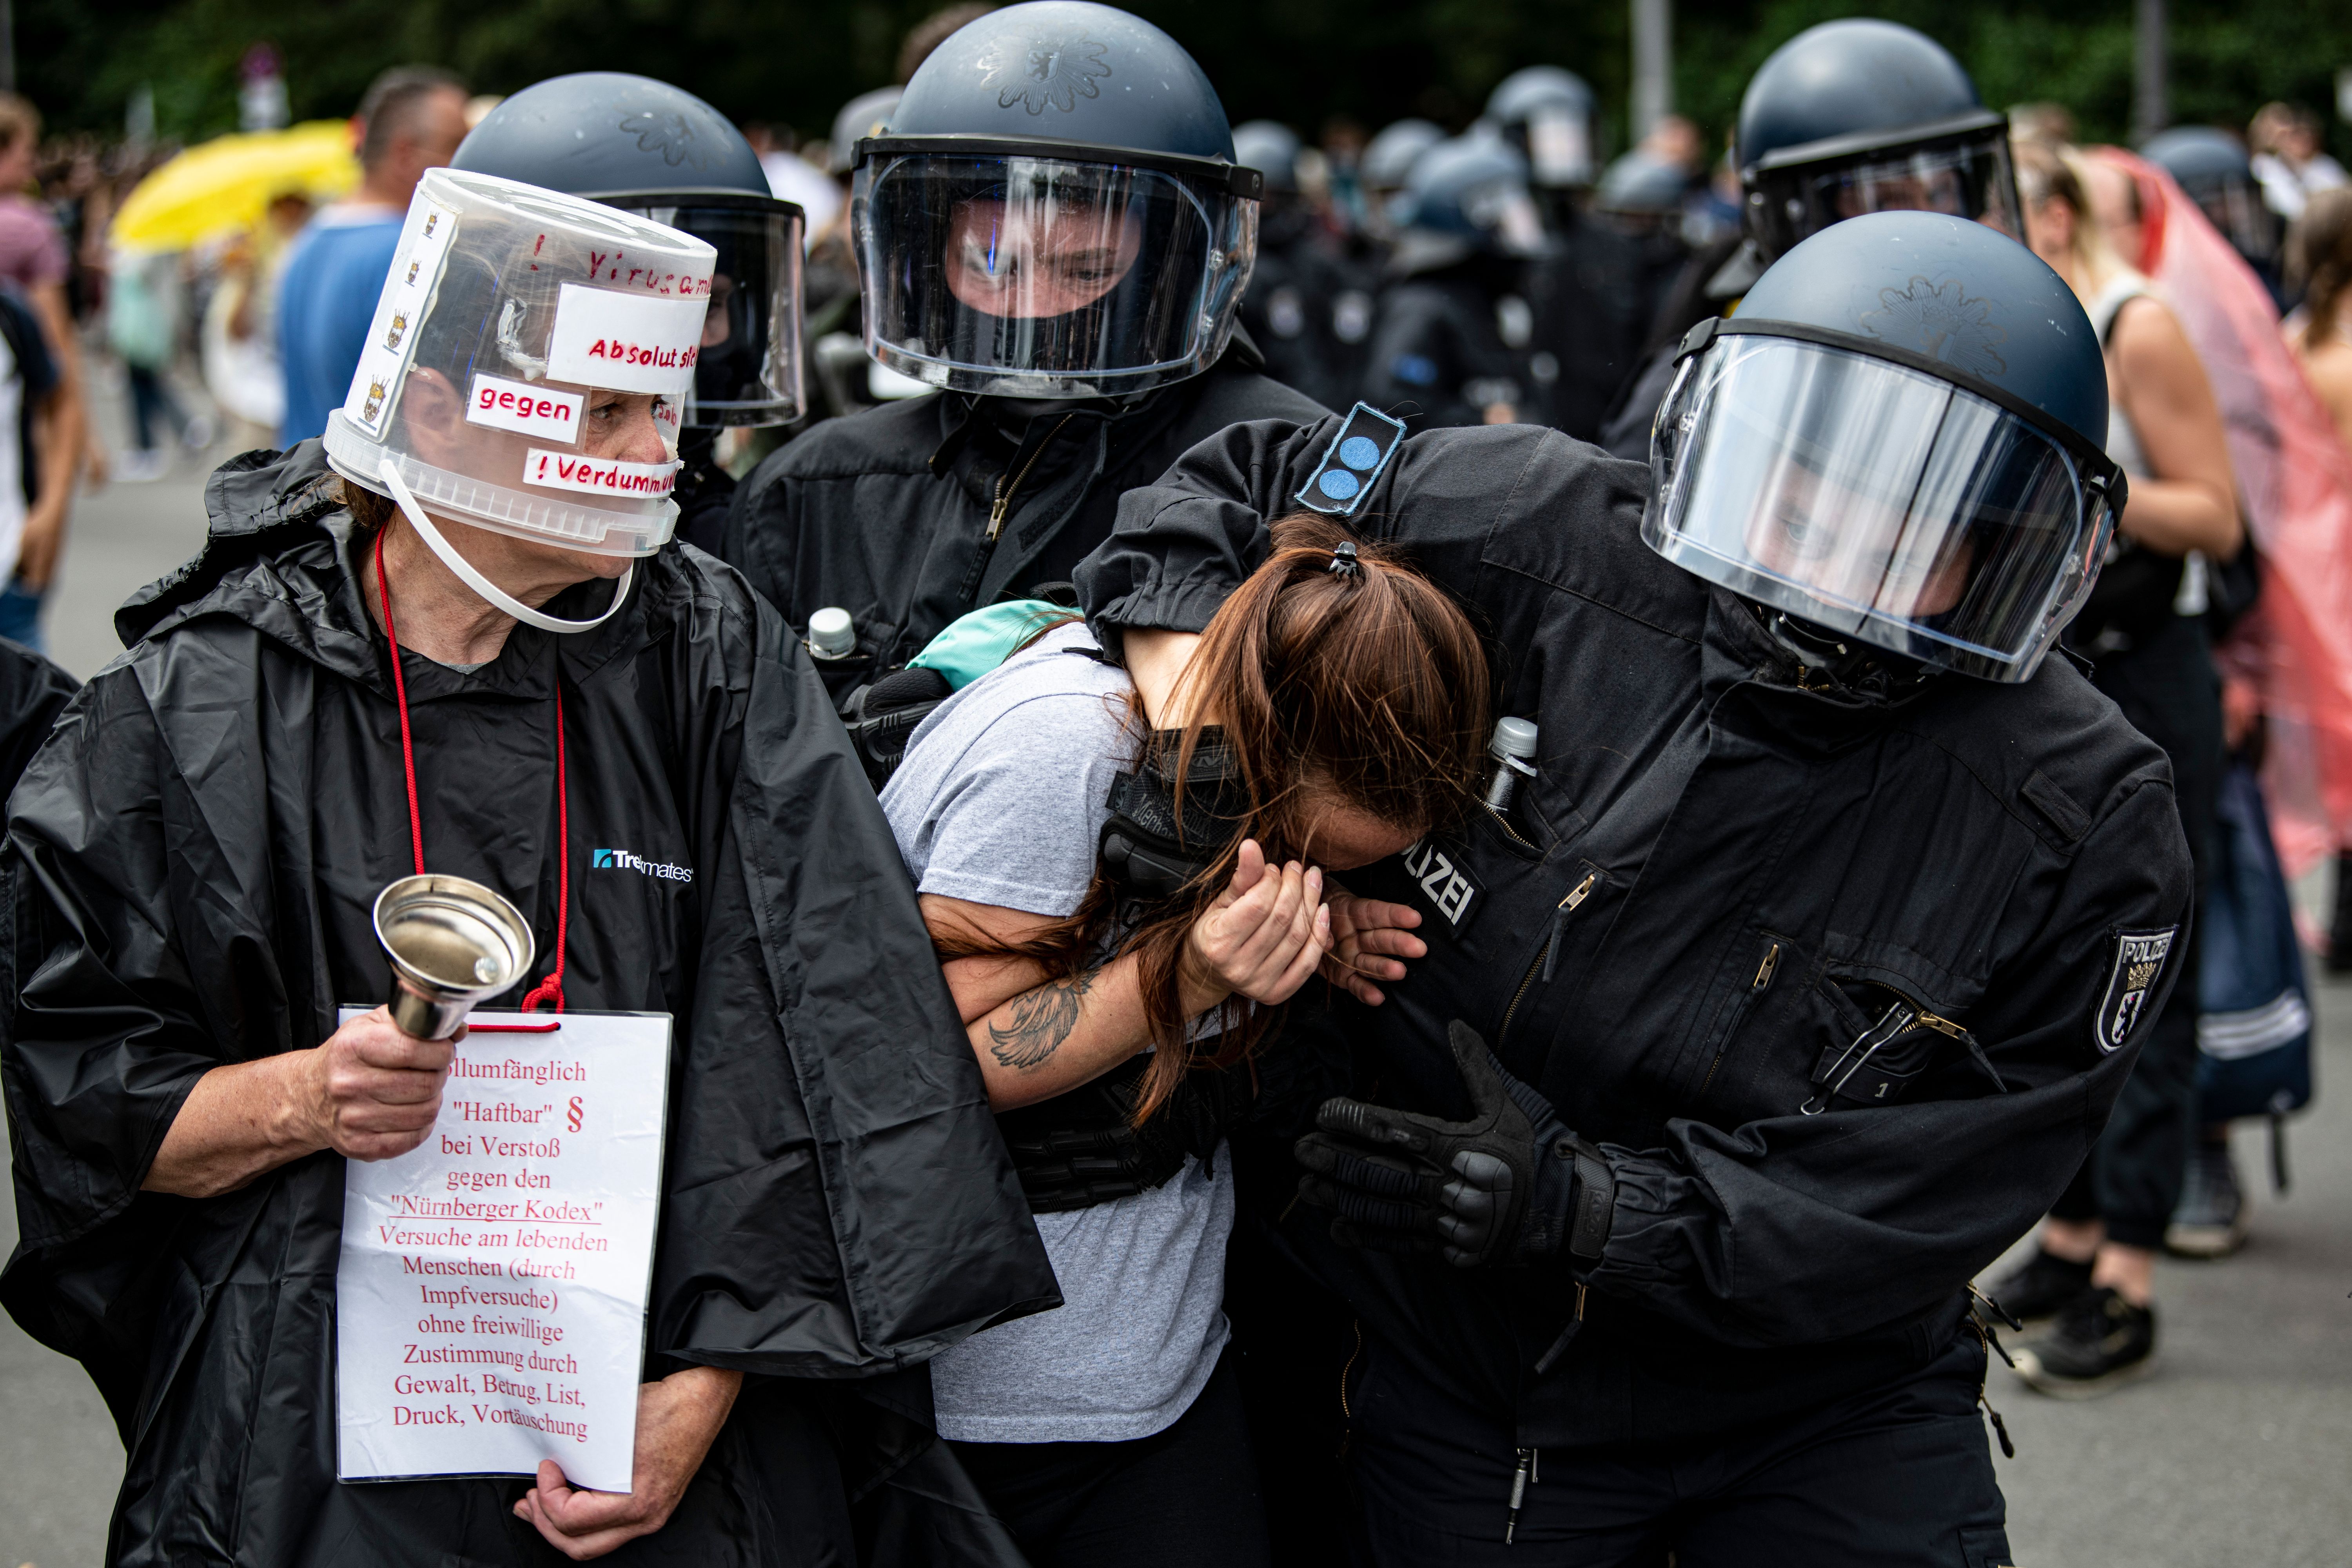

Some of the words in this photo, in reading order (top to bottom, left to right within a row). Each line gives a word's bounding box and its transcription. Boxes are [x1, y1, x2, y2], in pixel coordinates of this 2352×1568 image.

[589, 339, 677, 368] Absolut
[479, 387, 571, 421] gegen
[612, 850, 692, 882] Trekmates
[454, 1101, 552, 1123] "Haftbar"
[567, 1096, 583, 1133] §
[442, 1134, 472, 1154] bei
[481, 1136, 560, 1158] Verstoß
[447, 1172, 507, 1191] gegen
[515, 1168, 550, 1189] den
[391, 1195, 518, 1221] "Nürnberger
[524, 1200, 603, 1221] Kodex"
[379, 1225, 472, 1247] Versuche
[478, 1234, 508, 1247] am
[516, 1229, 608, 1252] lebenden
[403, 1256, 503, 1277] Menschen
[509, 1258, 575, 1281] (durch
[421, 1285, 558, 1314] Impfversuche)
[418, 1314, 465, 1333] ohne
[472, 1314, 563, 1346] freiwillige
[404, 1344, 524, 1372] Zustimmung
[528, 1350, 577, 1374] durch
[395, 1374, 476, 1396] Gewalt,
[483, 1374, 541, 1405] Betrug,
[546, 1383, 586, 1409] List,
[394, 1405, 465, 1427] Druck,
[472, 1404, 588, 1443] Vortäuschung
